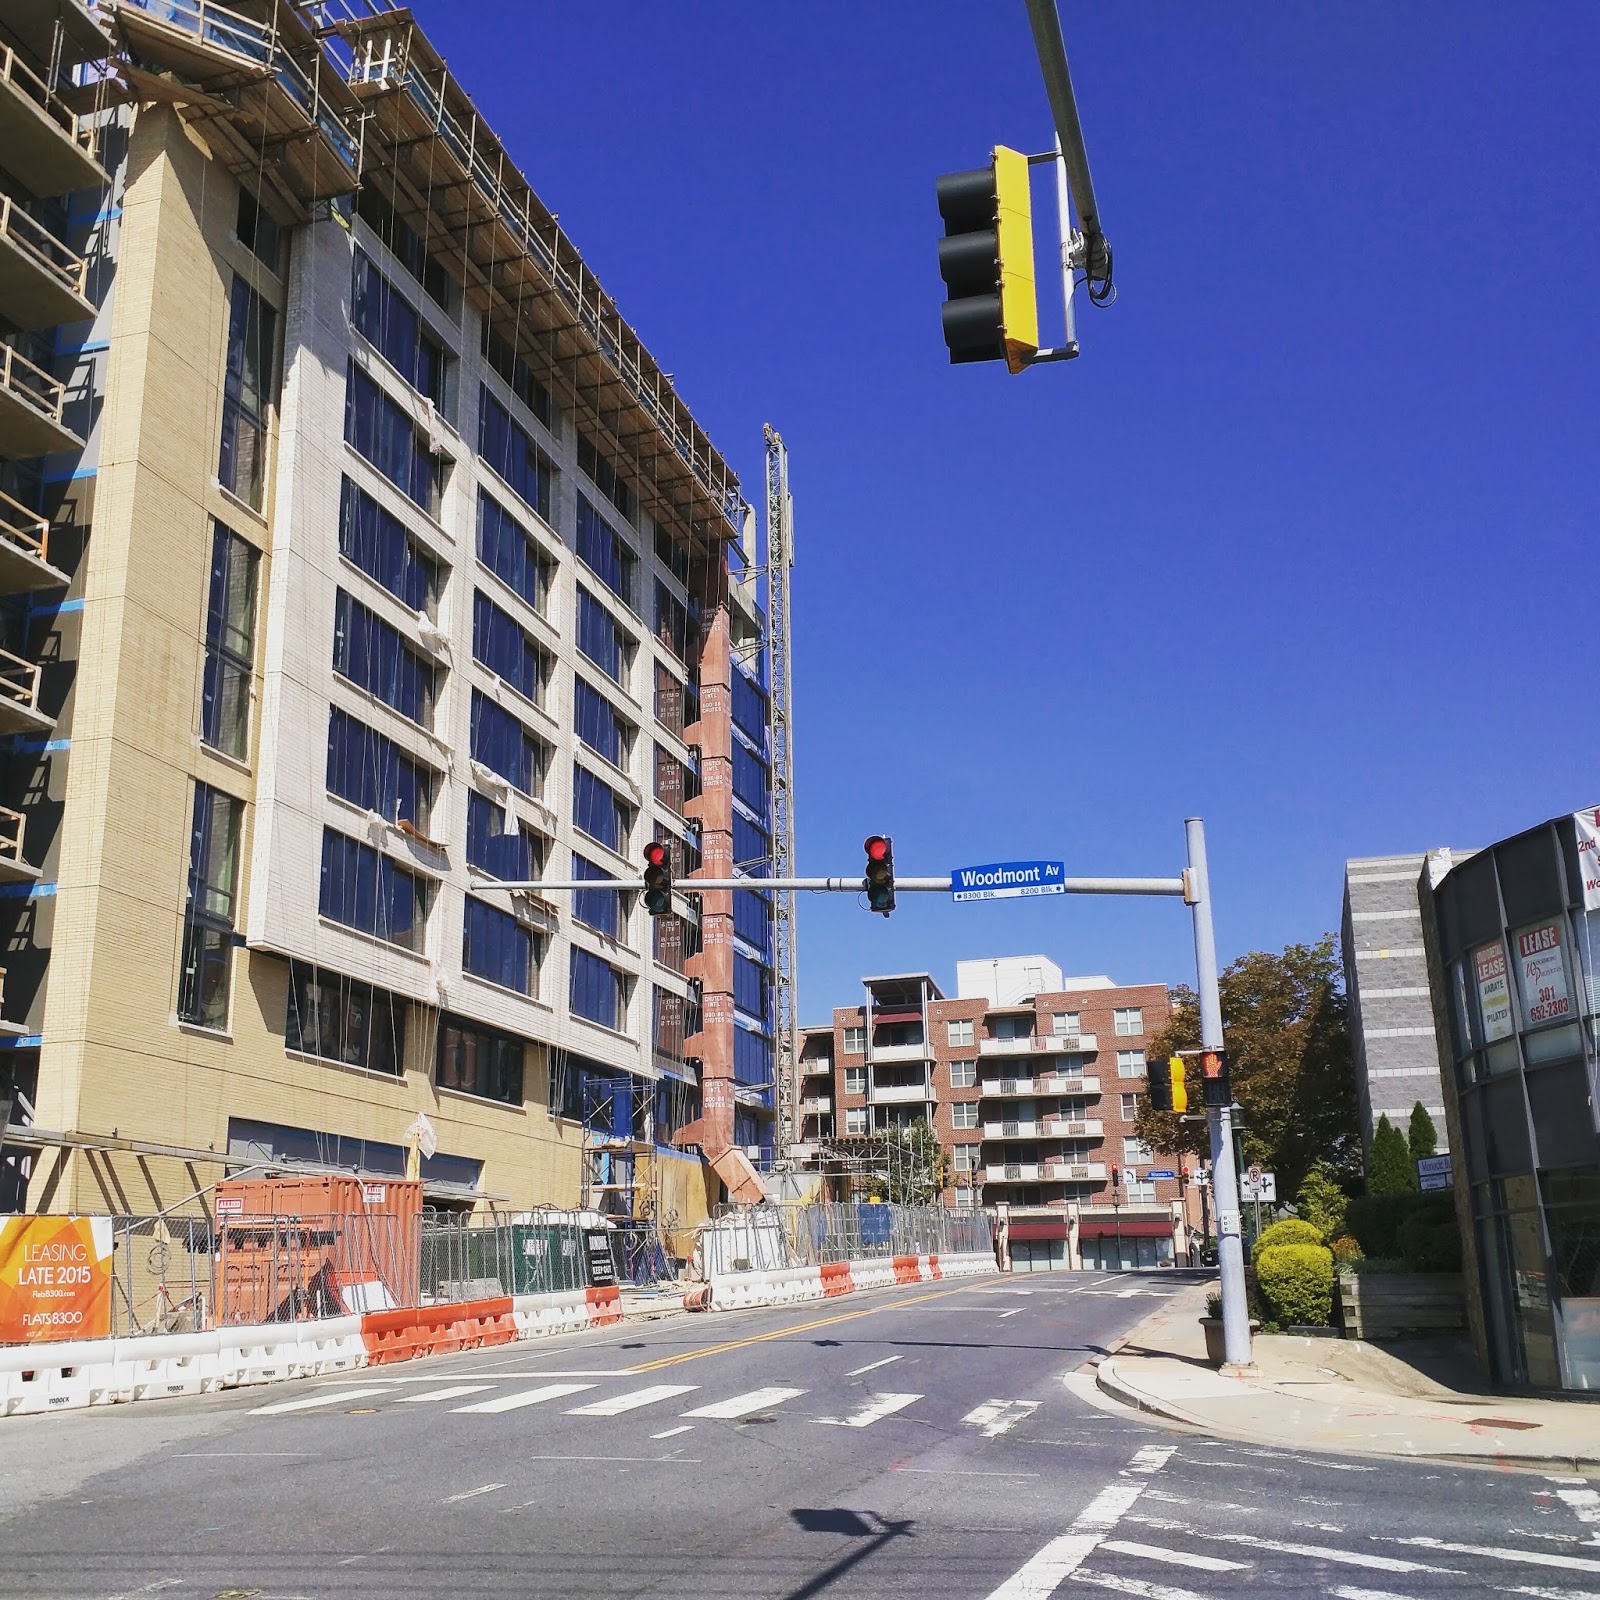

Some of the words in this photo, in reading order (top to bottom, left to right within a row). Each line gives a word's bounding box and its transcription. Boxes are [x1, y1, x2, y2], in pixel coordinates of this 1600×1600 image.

[1578, 837, 1596, 852] 2nd
[961, 867, 1040, 886] Woodmont
[1045, 864, 1059, 876] Av
[1020, 887, 1039, 895] 8200
[1523, 927, 1556, 955] LEASE
[1478, 957, 1505, 980] LEASE
[1484, 980, 1505, 995] KARATE
[1539, 986, 1555, 1003] 301
[1487, 1008, 1508, 1023] PILATES
[1530, 997, 1569, 1021] 652-2303
[24, 1243, 87, 1262] LEASING
[18, 1266, 54, 1285] LATE
[57, 1266, 91, 1284] 2015
[32, 1289, 76, 1298] Flats8300.com
[22, 1311, 83, 1326] FLATS8300
